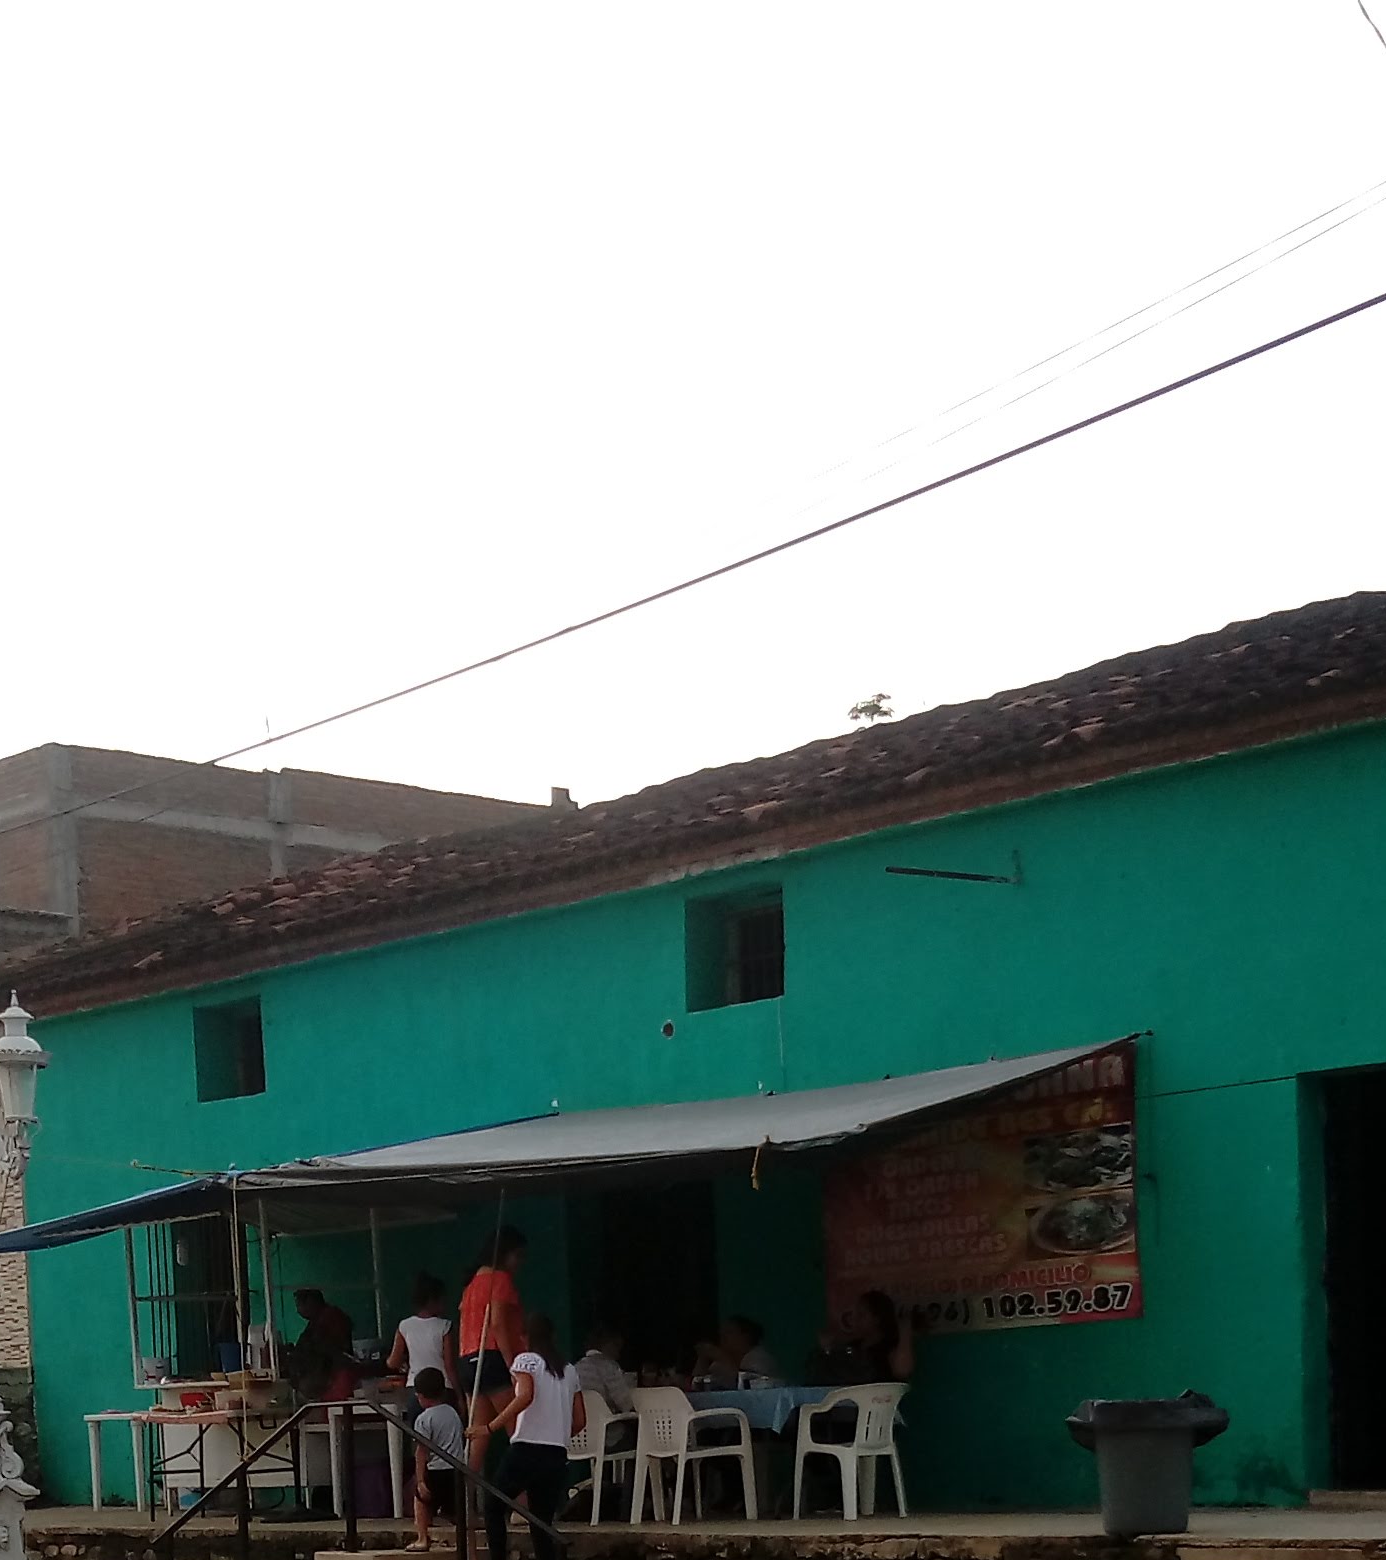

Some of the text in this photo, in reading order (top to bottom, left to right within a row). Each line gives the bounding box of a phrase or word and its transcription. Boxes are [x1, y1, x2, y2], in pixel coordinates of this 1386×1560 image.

[917, 1233, 1008, 1260] FRESCAS
[981, 1262, 1091, 1291] DOMICILIO
[981, 1282, 1134, 1320] 102.59.87
